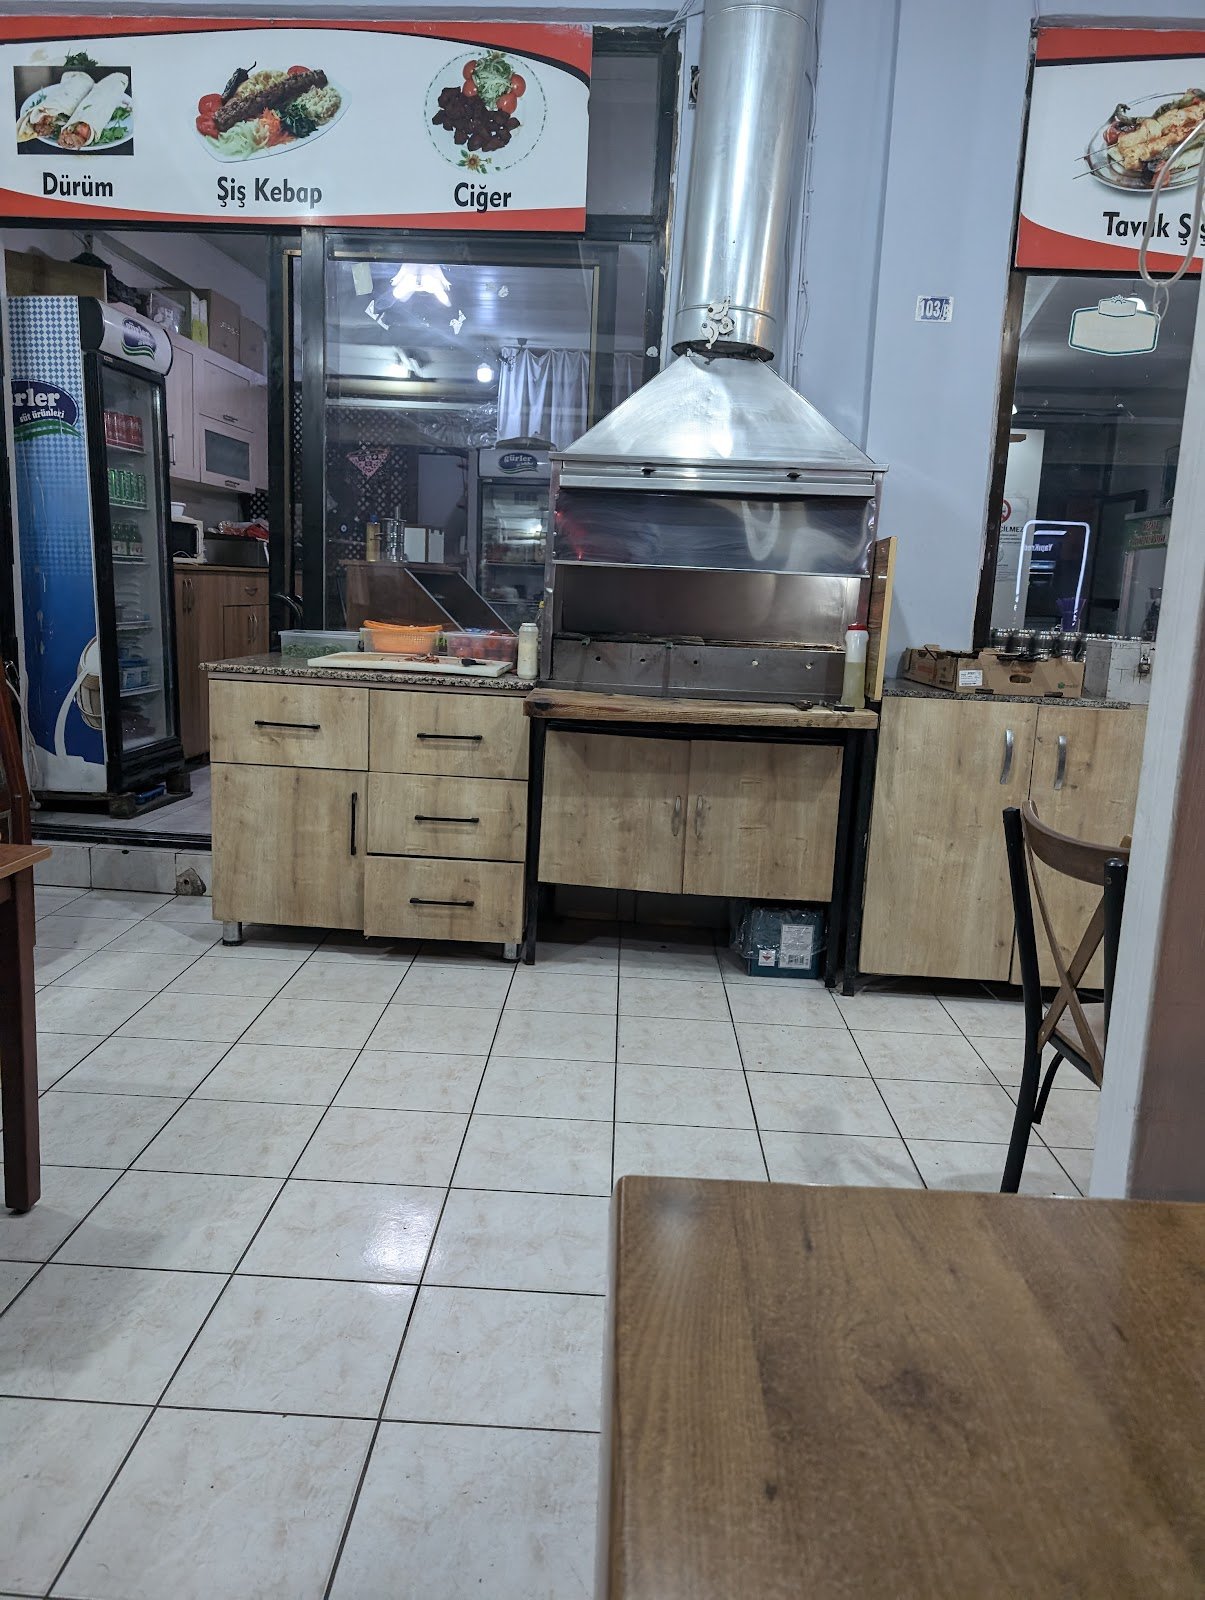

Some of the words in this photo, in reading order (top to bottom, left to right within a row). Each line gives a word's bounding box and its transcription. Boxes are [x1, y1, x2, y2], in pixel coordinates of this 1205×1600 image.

[43, 172, 113, 197] Dürüm
[217, 176, 246, 208] Şiş
[254, 177, 322, 209] Kebap
[454, 182, 512, 213] Ciğer
[1103, 211, 1170, 238] Tavuk
[12, 388, 61, 407] rler
[20, 412, 31, 422] süt
[31, 408, 65, 419] ürünleri
